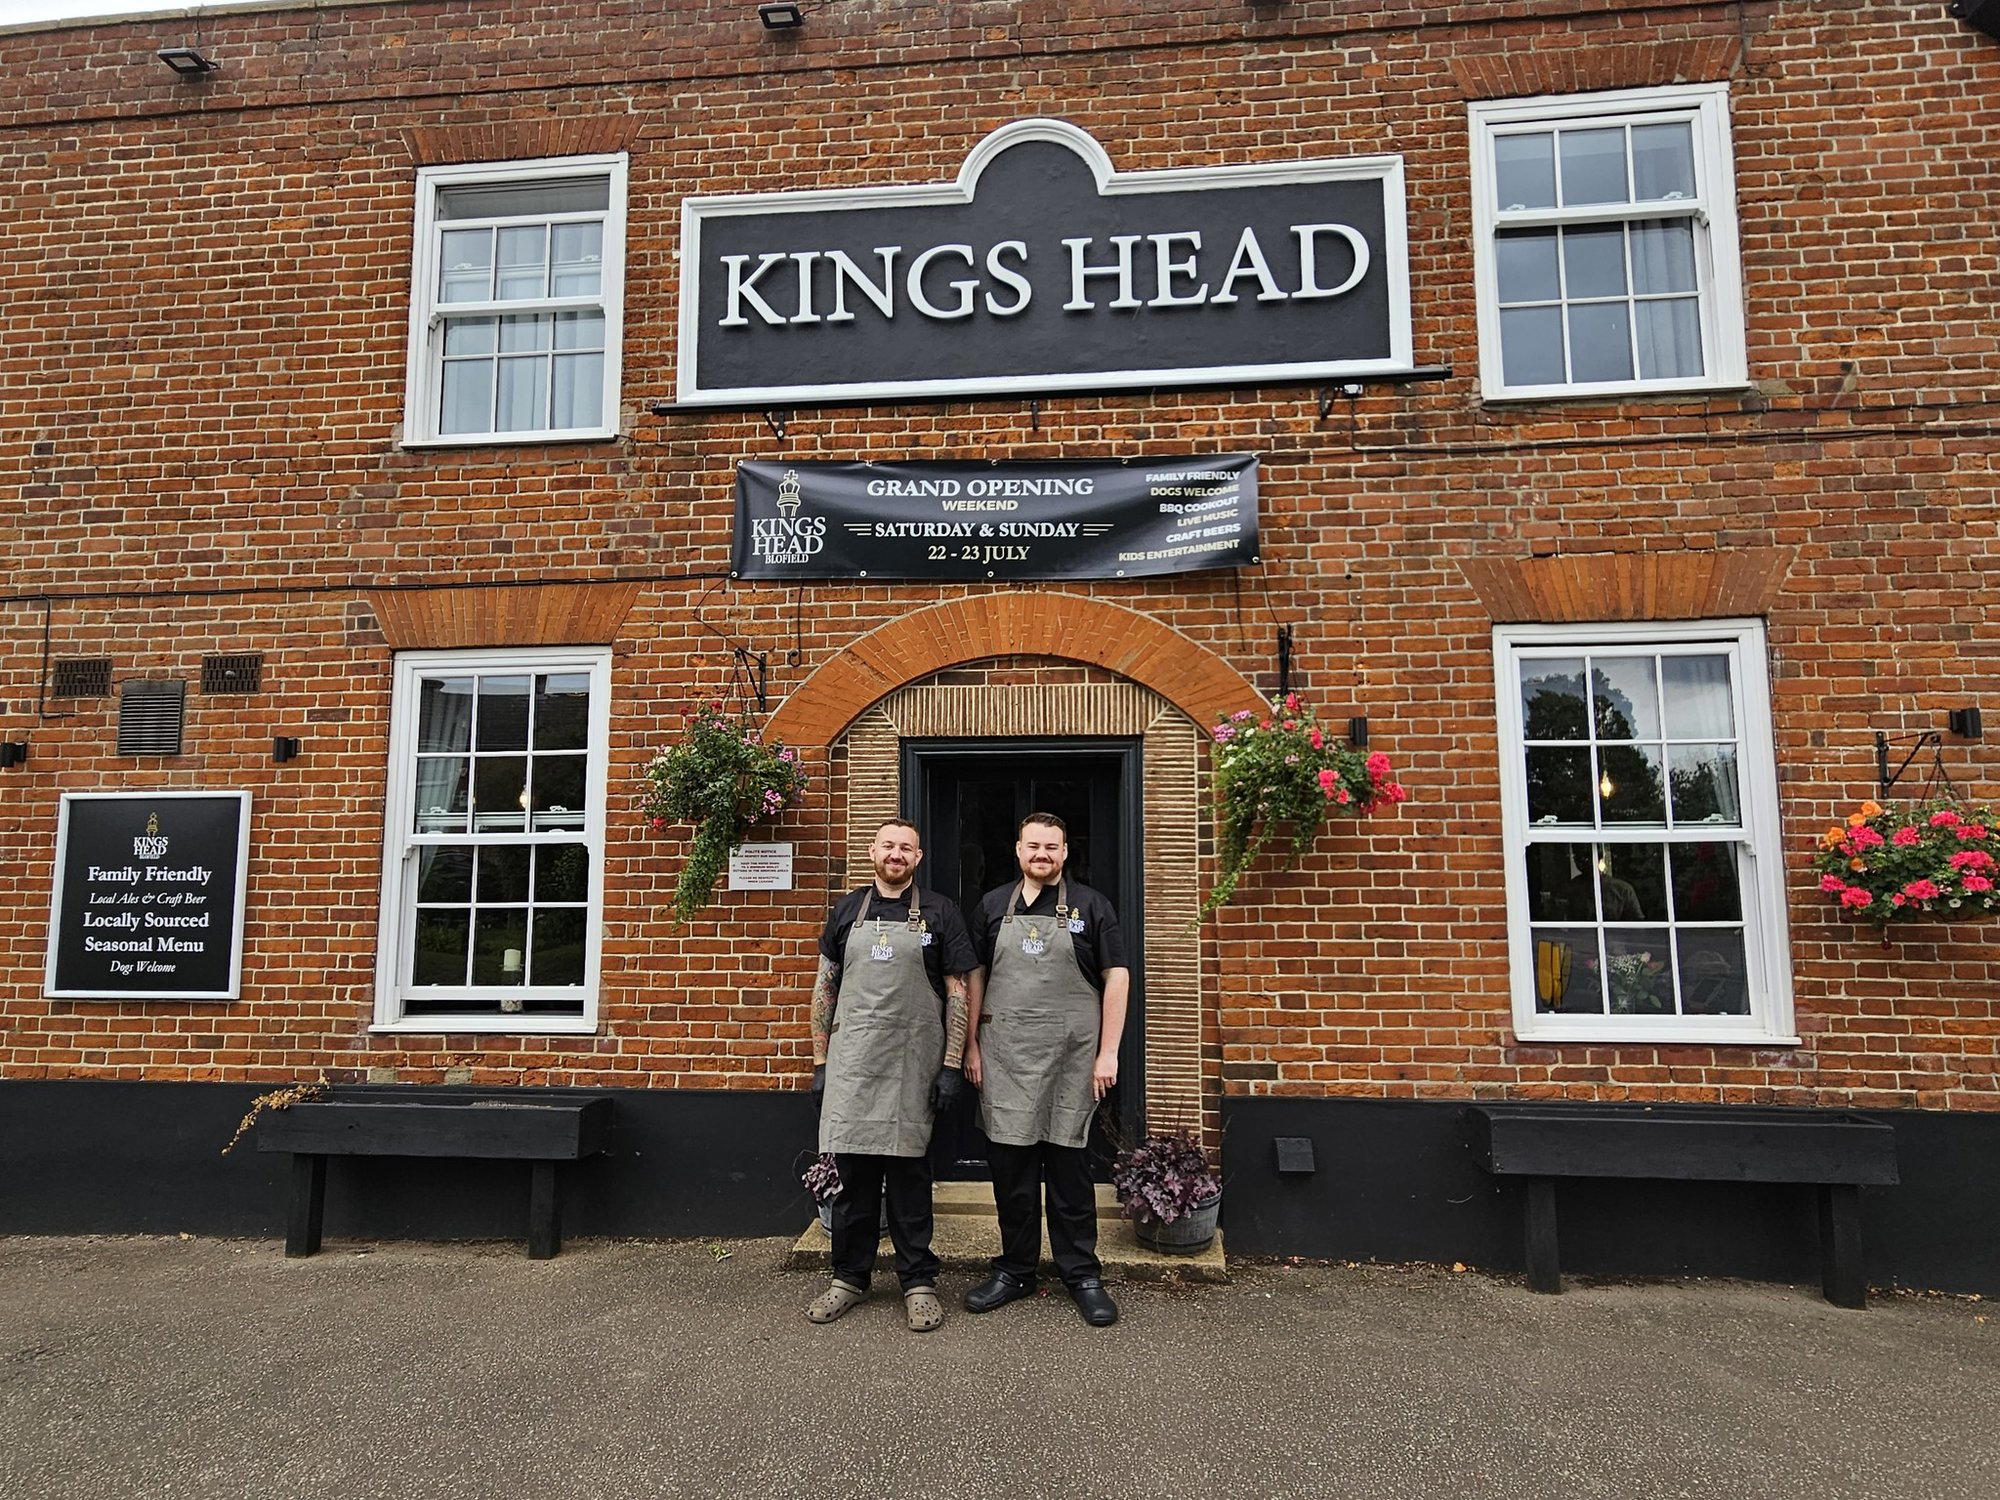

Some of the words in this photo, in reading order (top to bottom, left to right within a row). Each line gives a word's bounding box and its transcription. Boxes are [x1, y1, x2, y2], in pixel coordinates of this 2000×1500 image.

[718, 240, 1033, 327] KINGS
[1061, 224, 1372, 312] HEAD
[1145, 472, 1186, 482] FAMILY
[1187, 471, 1241, 481] FRIENDLY
[867, 479, 960, 497] GRAND
[967, 478, 1094, 497] OPENING
[1151, 486, 1183, 496] DOGS
[1184, 485, 1240, 497] WELCOME
[942, 500, 1019, 512] WEEKEND
[1159, 503, 1184, 514] BBQ
[1185, 496, 1239, 512] COOKOUT
[1177, 516, 1202, 527] LIVE
[1203, 509, 1239, 523] MUSIC
[751, 517, 827, 538] KINGS
[875, 522, 976, 538] SATURDAY
[979, 523, 995, 537] &
[999, 523, 1080, 538] SUNDAY
[1166, 530, 1203, 543] CRAFT
[1204, 523, 1241, 537] BEERS
[752, 535, 824, 556] HEAD
[928, 545, 946, 560] 22
[962, 546, 980, 560] 23
[983, 545, 1031, 564] JULY
[1119, 551, 1145, 562] KIDS
[1147, 539, 1240, 560] ENTERTAINMENT
[765, 554, 809, 564] BLOFIELD
[134, 837, 168, 847] KINGS
[134, 846, 166, 855] HEAD
[87, 866, 141, 885] Family
[145, 866, 212, 885] Friendly
[89, 894, 115, 904] Local
[117, 894, 140, 904] Ales
[141, 895, 155, 904] &
[157, 893, 182, 907] Craft
[184, 894, 206, 904] Beer
[83, 912, 141, 931] Locally
[144, 912, 209, 927] Sourced
[85, 936, 152, 951] Seasonal
[157, 937, 204, 951] Menu
[110, 961, 133, 975] Dogs
[136, 961, 176, 973] Welcome
